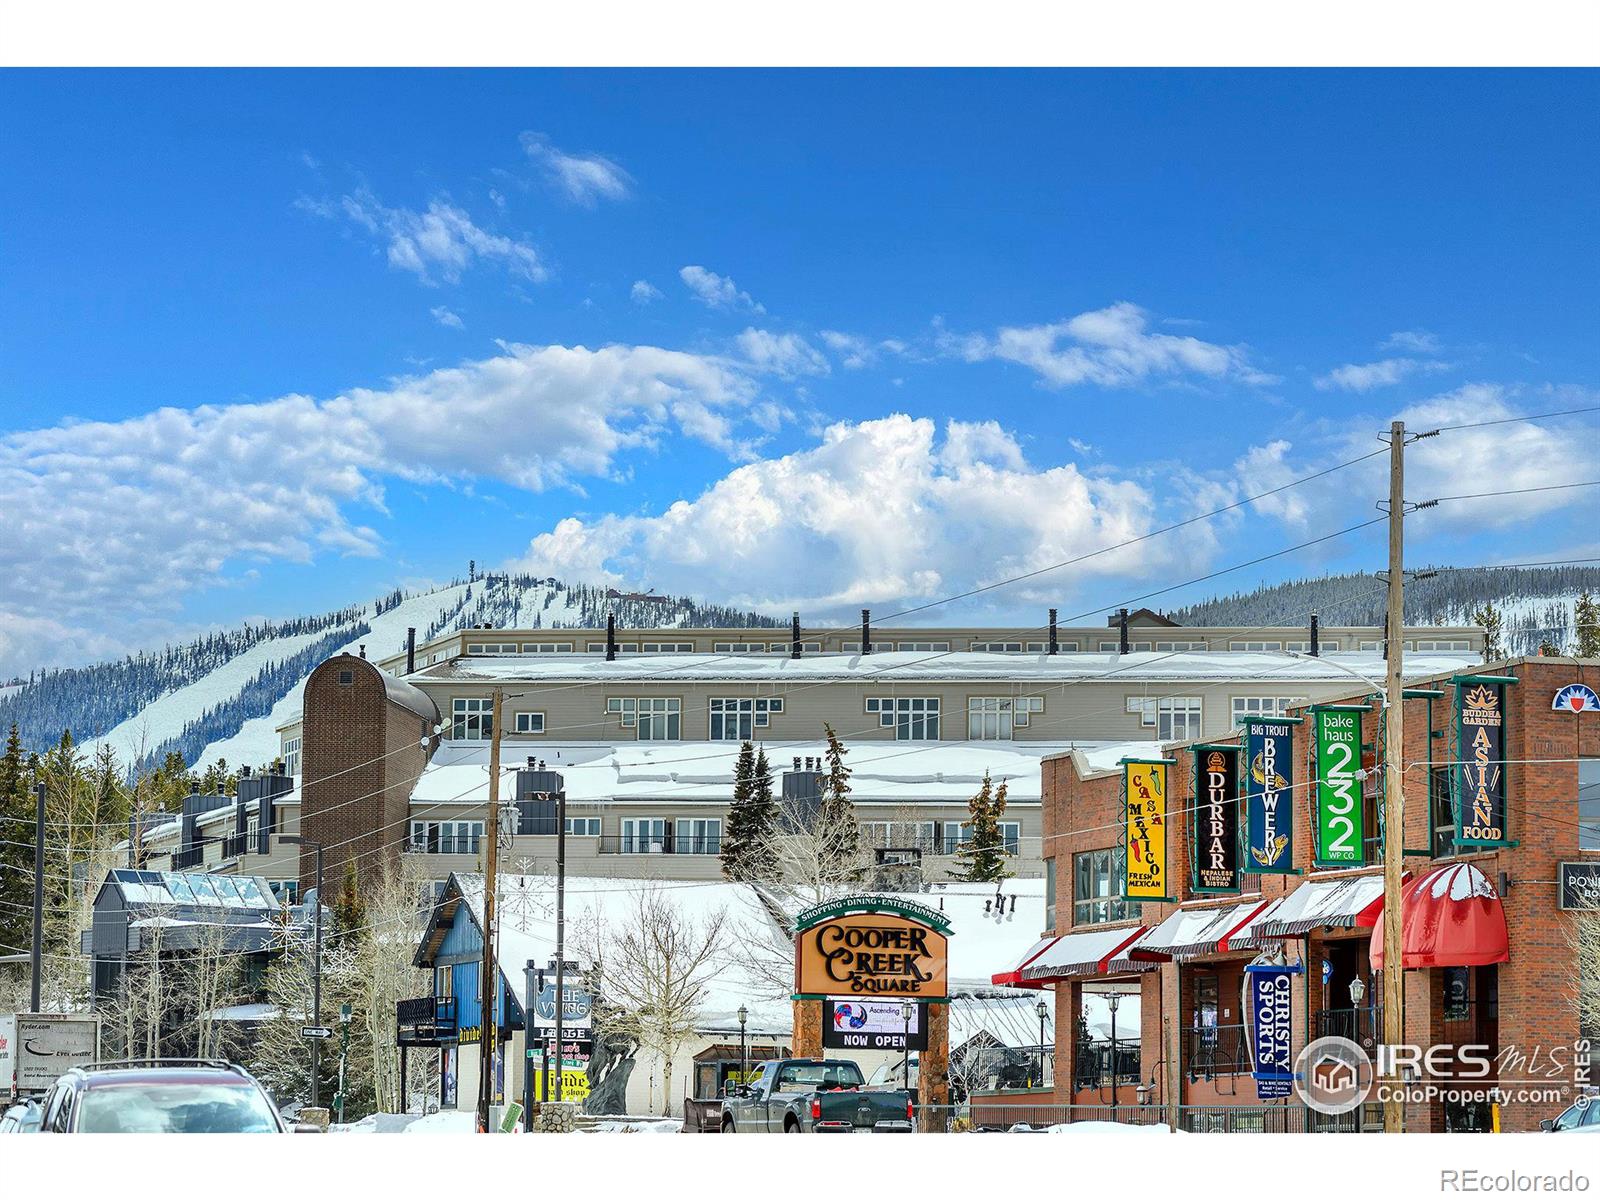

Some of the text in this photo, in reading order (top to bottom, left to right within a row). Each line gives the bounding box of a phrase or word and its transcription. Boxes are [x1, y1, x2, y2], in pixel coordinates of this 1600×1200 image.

[1323, 714, 1354, 728] bake
[1463, 709, 1501, 718] BUDDHA
[1463, 718, 1501, 726] GARDEN
[1251, 725, 1289, 736] BIG TROUT
[1324, 728, 1354, 742] haus
[1472, 727, 1492, 827] ASIAN
[1262, 738, 1280, 867] BREWERY
[1327, 743, 1355, 852] 232
[1208, 772, 1226, 870] DURBAR
[1463, 827, 1502, 840] FOOD
[1343, 852, 1355, 860] CO
[1129, 880, 1160, 888] MEXICAN
[801, 897, 948, 926] SHOPPING DINING ENTERTAINMENT
[816, 924, 933, 958] COOPER
[825, 947, 933, 982] CREEK
[851, 975, 921, 993] SQUARE
[869, 1007, 899, 1016] Ascending
[1259, 981, 1274, 1064] SPORTS
[1275, 975, 1290, 1071] CHRISTY
[844, 1035, 906, 1047] NOW OPEN
